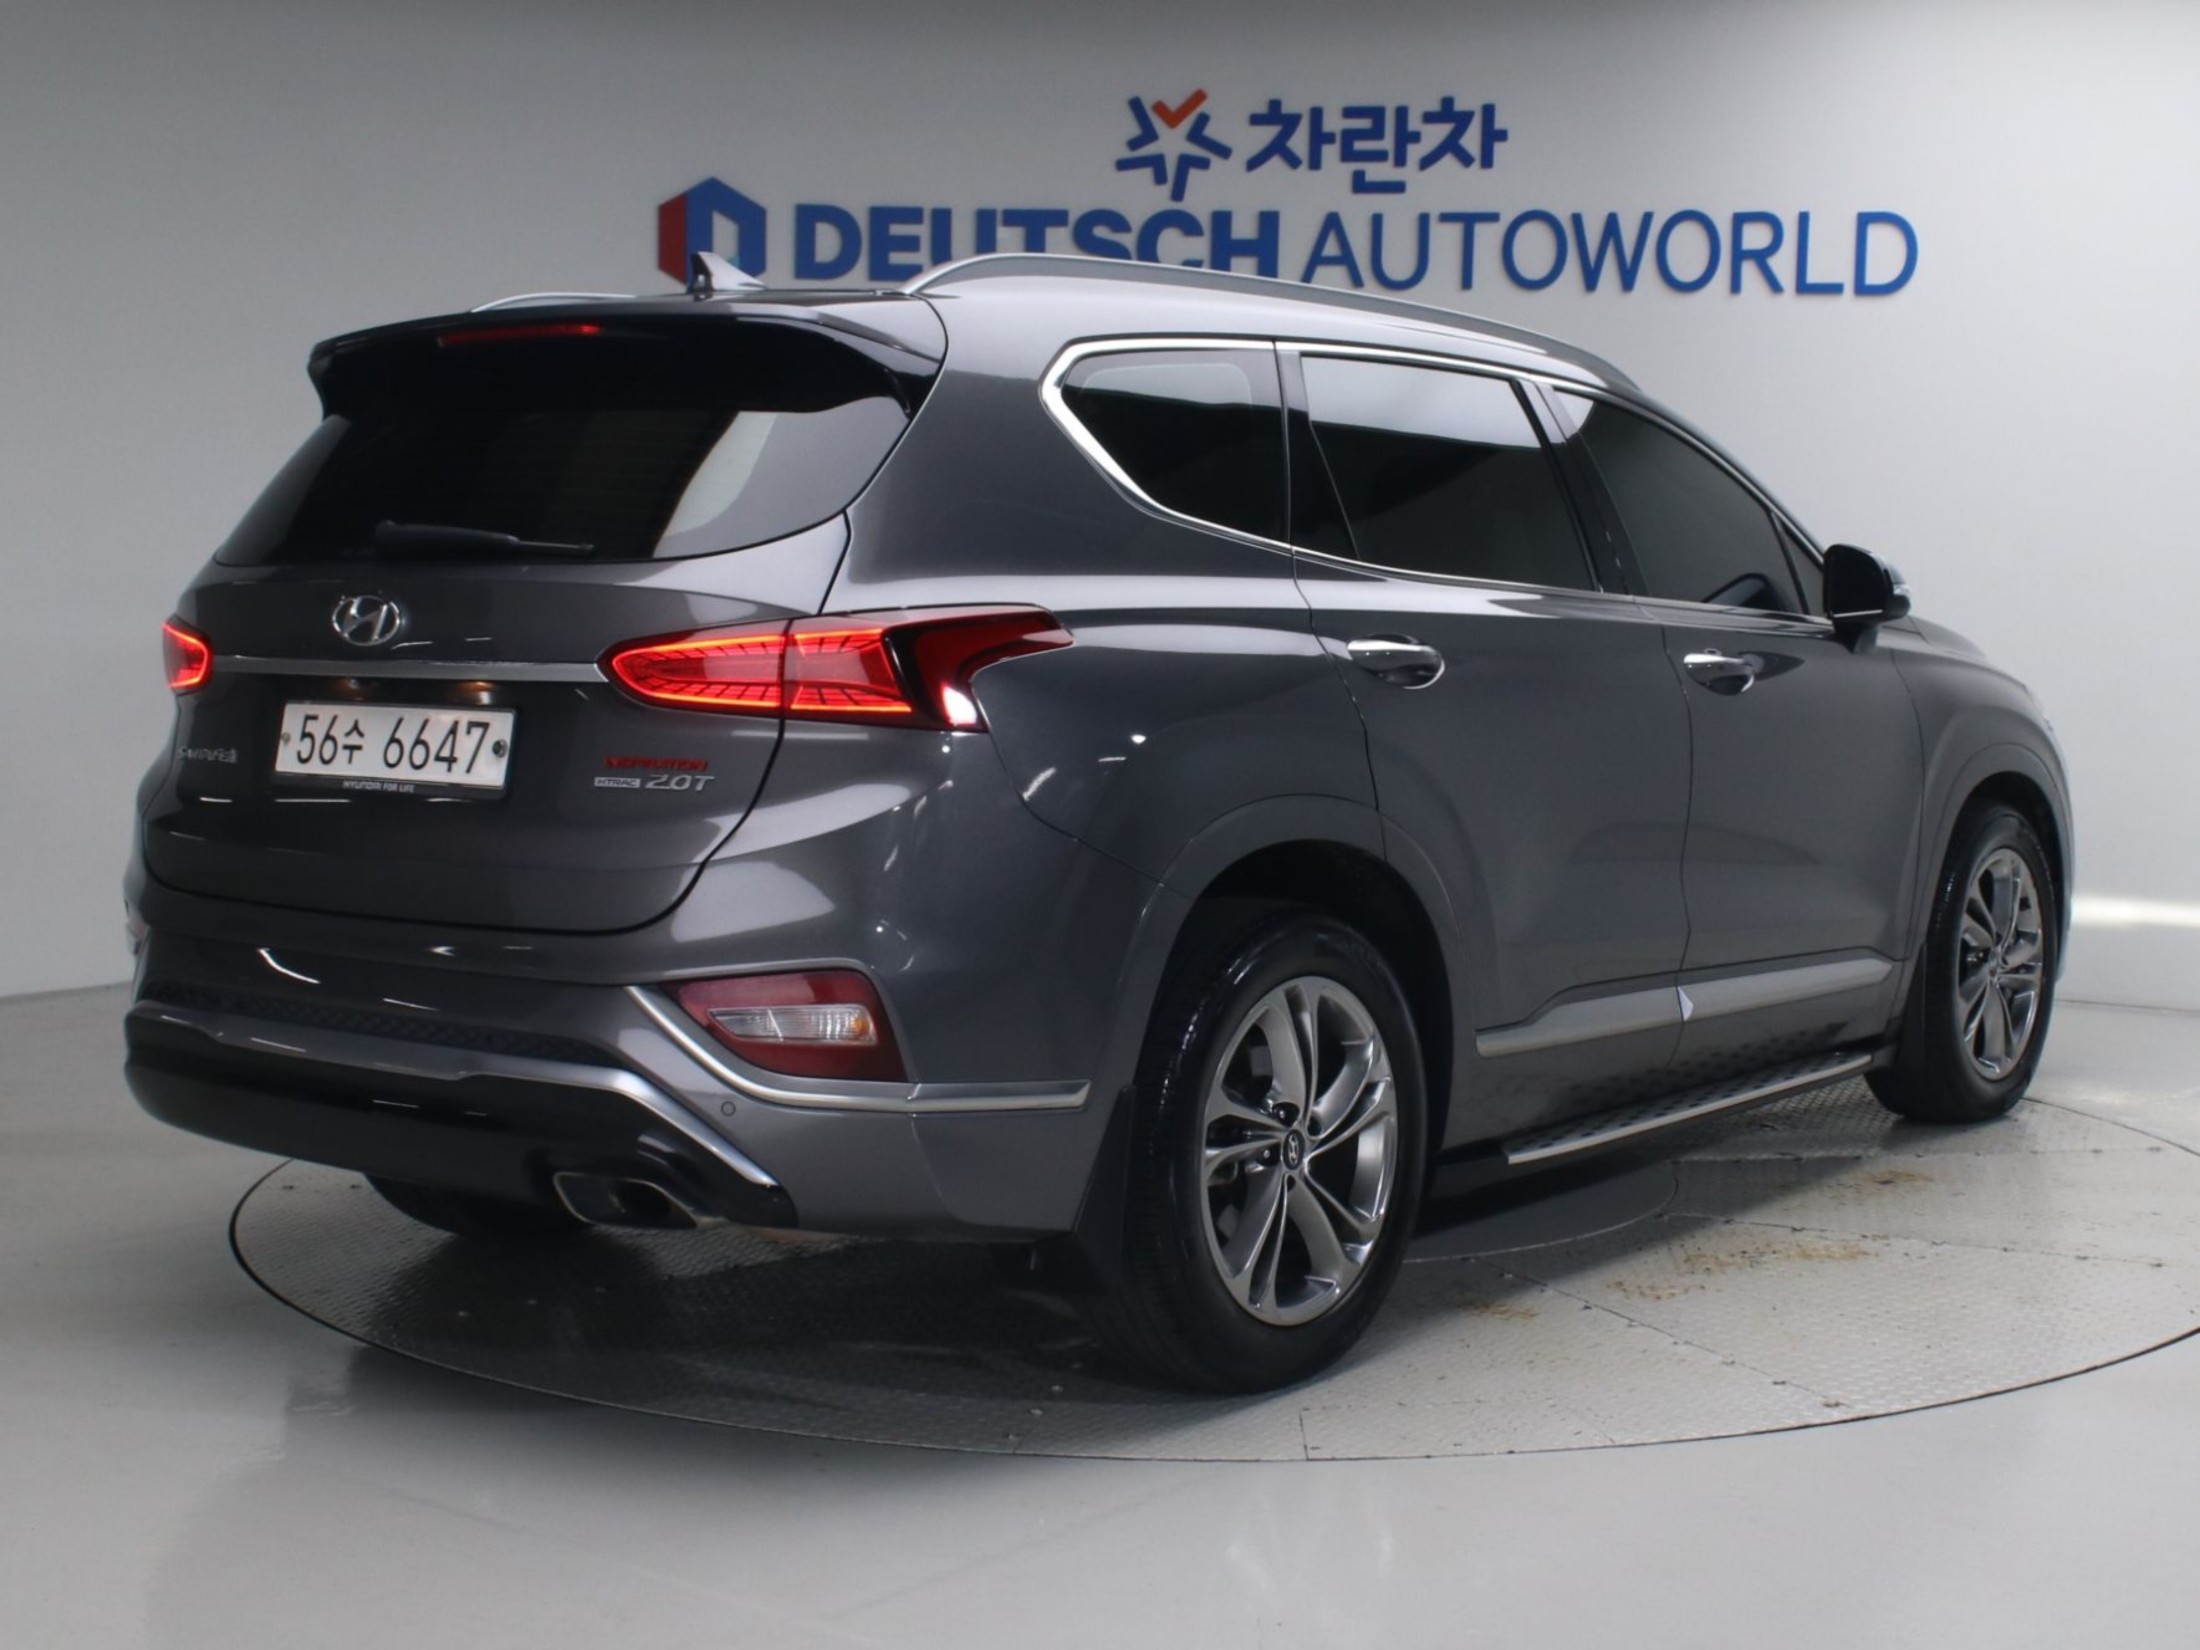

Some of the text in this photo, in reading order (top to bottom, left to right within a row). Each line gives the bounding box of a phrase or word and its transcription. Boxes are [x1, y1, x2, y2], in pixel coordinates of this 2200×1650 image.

[1246, 97, 1508, 193] 차란차
[795, 204, 1919, 296] DEUTSCH AUTOWORLD
[296, 714, 491, 773] 56수 6647
[383, 782, 399, 792] FOR
[399, 783, 416, 794] LIFE
